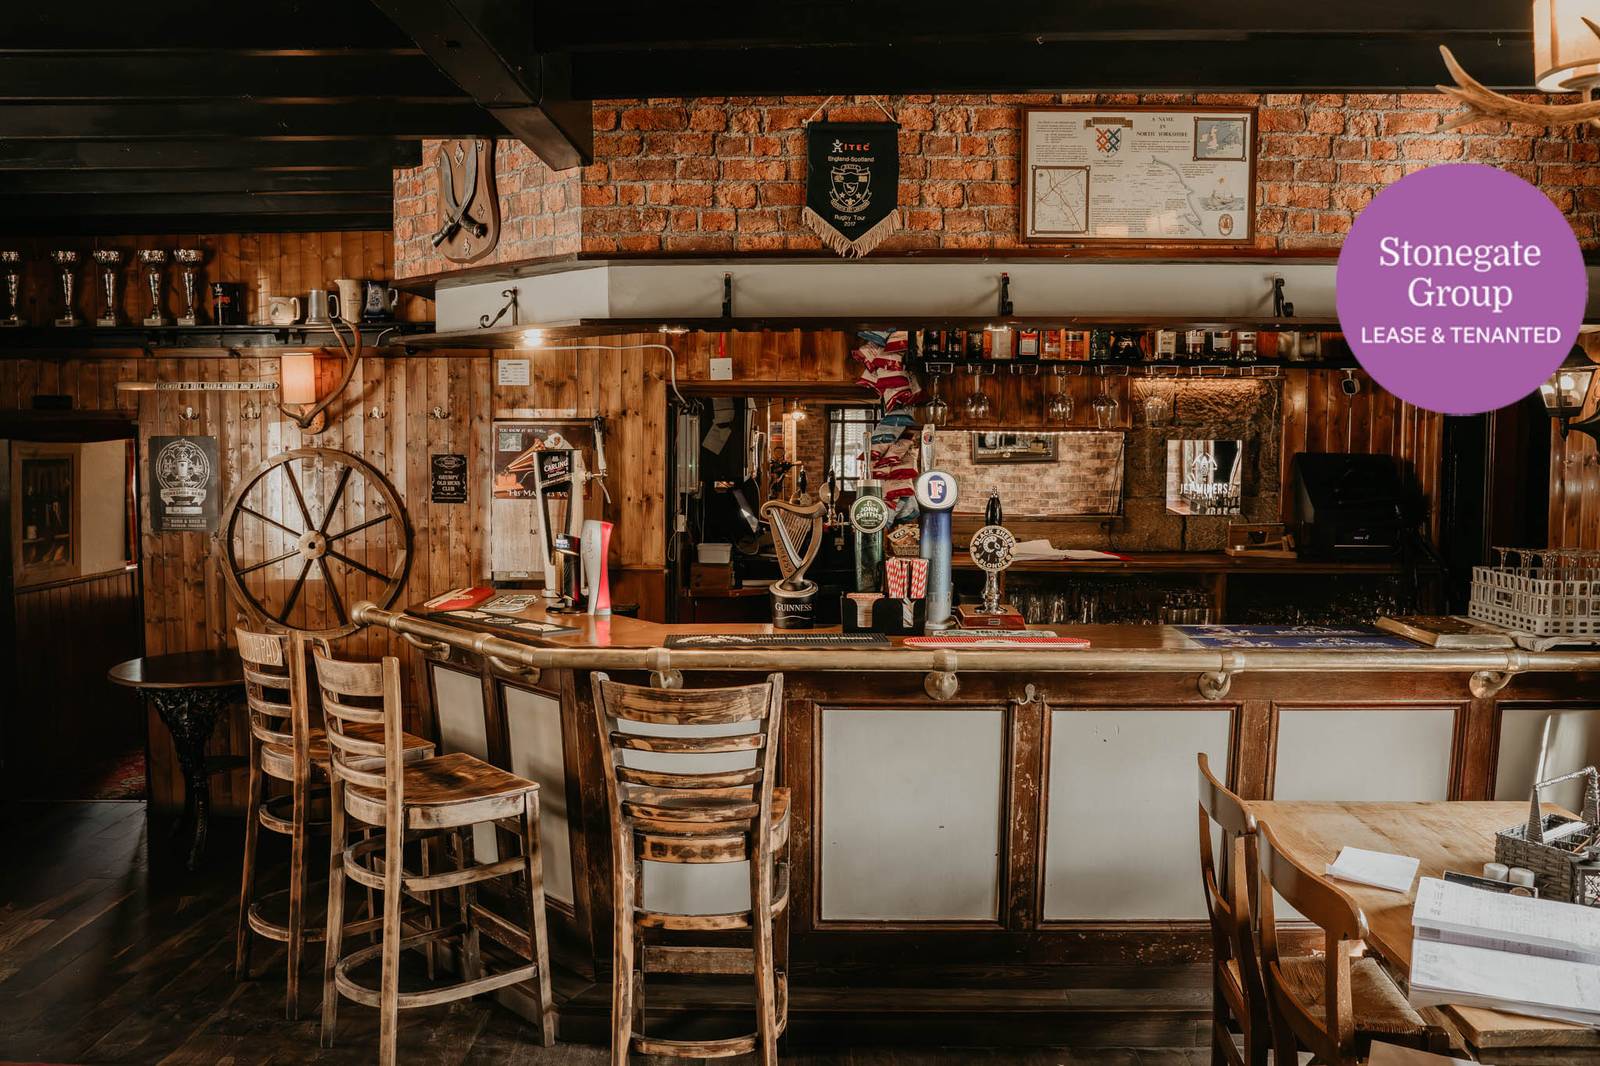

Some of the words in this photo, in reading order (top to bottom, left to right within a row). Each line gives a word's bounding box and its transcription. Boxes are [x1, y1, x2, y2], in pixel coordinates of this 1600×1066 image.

[544, 460, 568, 472] CARLING
[929, 480, 944, 498] F
[974, 530, 994, 546] BLACK
[996, 530, 1014, 547] SHEEP
[979, 558, 1008, 568] BLONDE
[774, 602, 812, 612] GUINNESS
